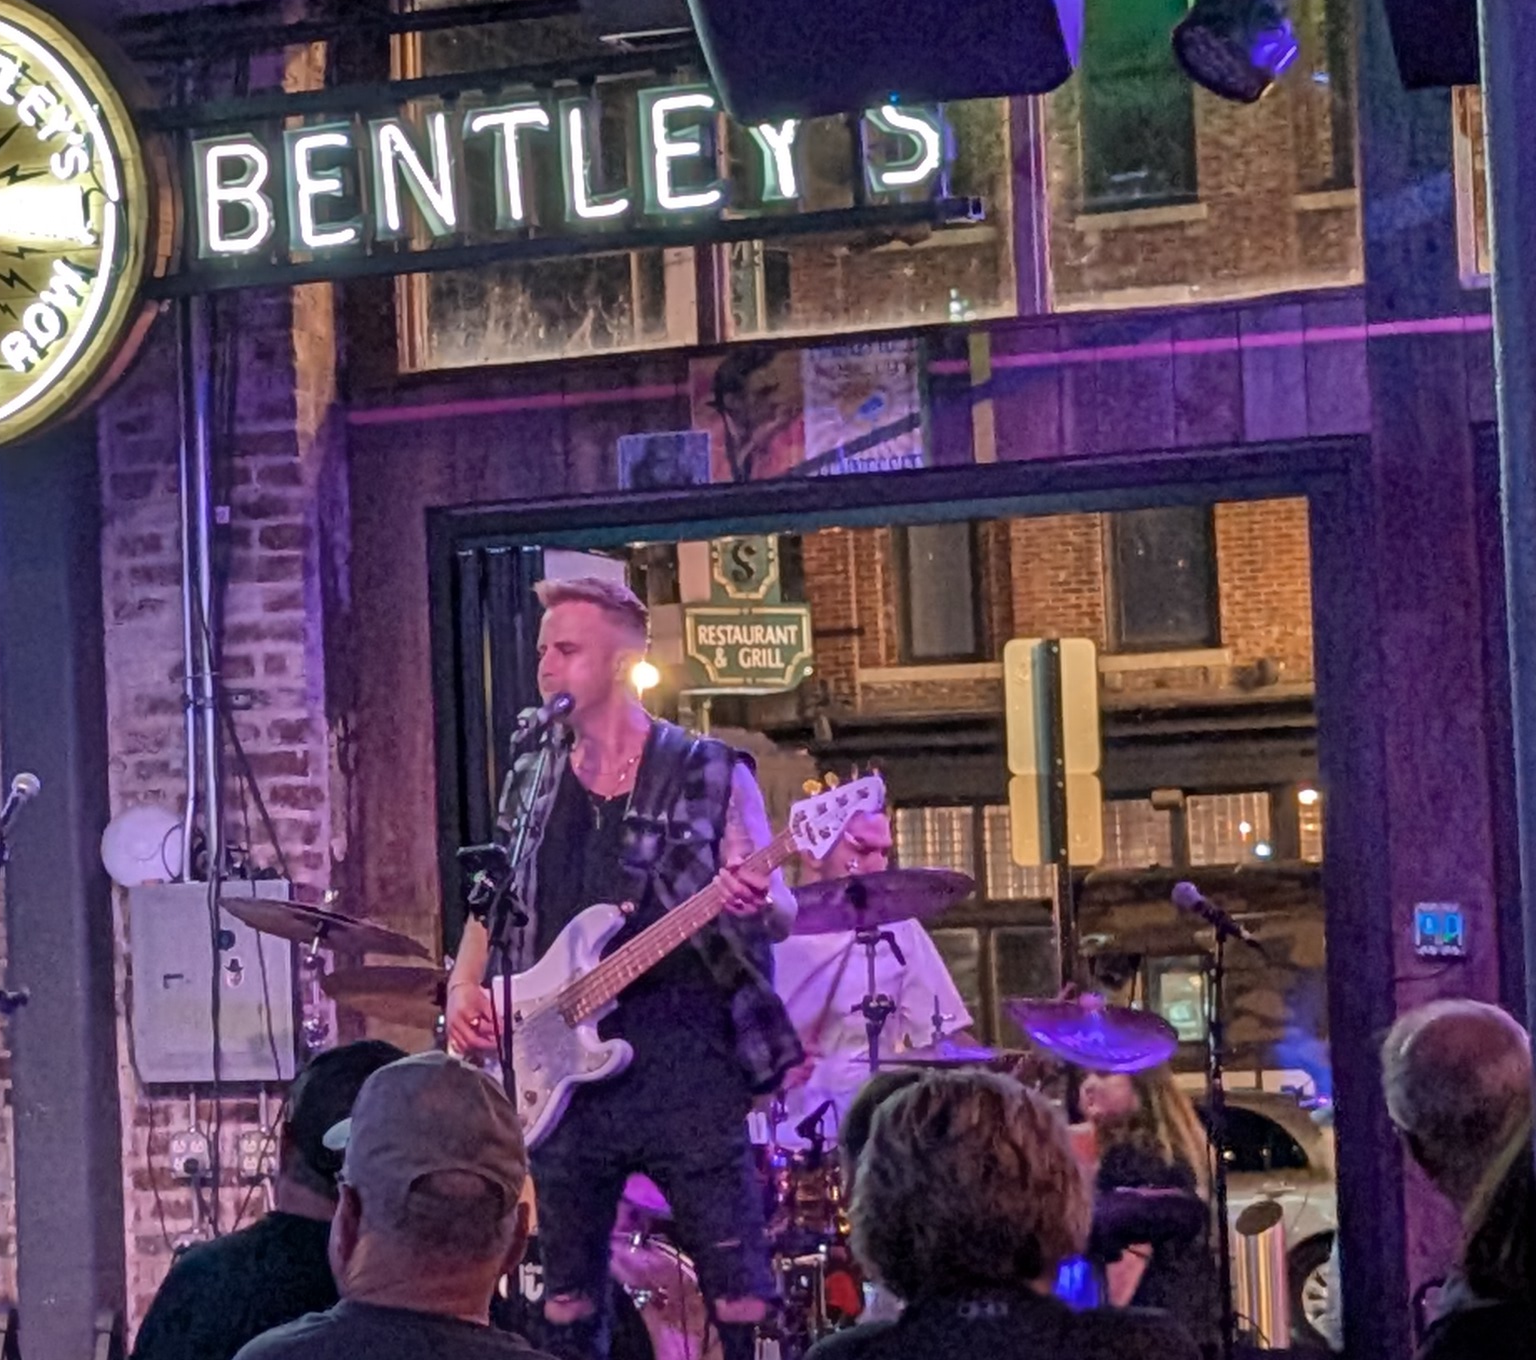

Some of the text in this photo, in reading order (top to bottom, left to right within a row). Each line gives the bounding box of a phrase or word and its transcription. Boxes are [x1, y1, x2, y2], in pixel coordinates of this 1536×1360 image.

[697, 624, 798, 646] RESTAURANT
[714, 647, 786, 669] & GRILL
